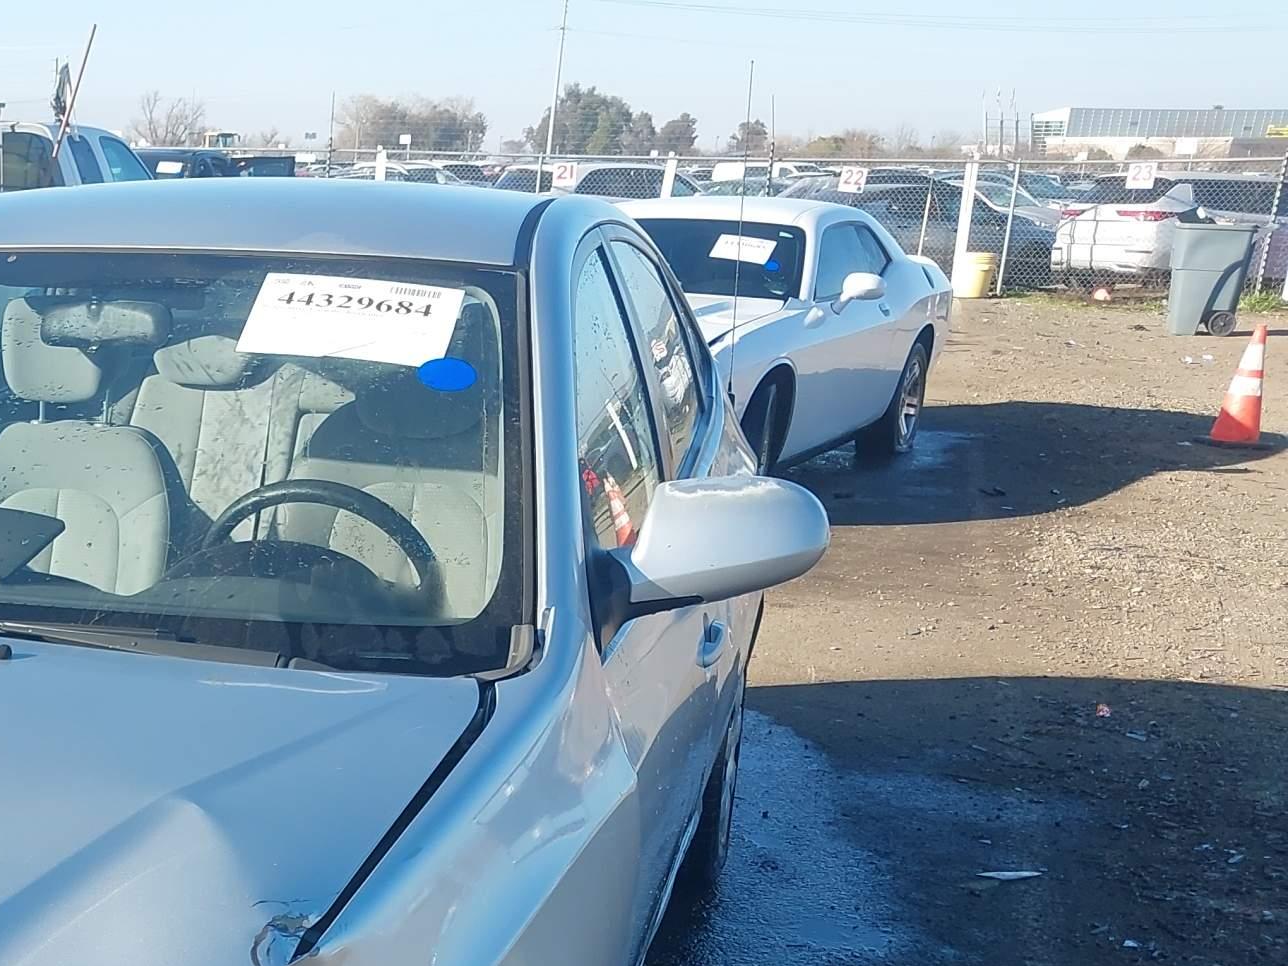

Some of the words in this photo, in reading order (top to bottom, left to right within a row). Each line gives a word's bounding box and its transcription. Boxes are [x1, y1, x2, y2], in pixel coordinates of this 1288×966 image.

[557, 164, 574, 180] 21
[843, 169, 864, 185] 22
[1132, 164, 1153, 181] 23
[277, 290, 433, 317] 44329684
